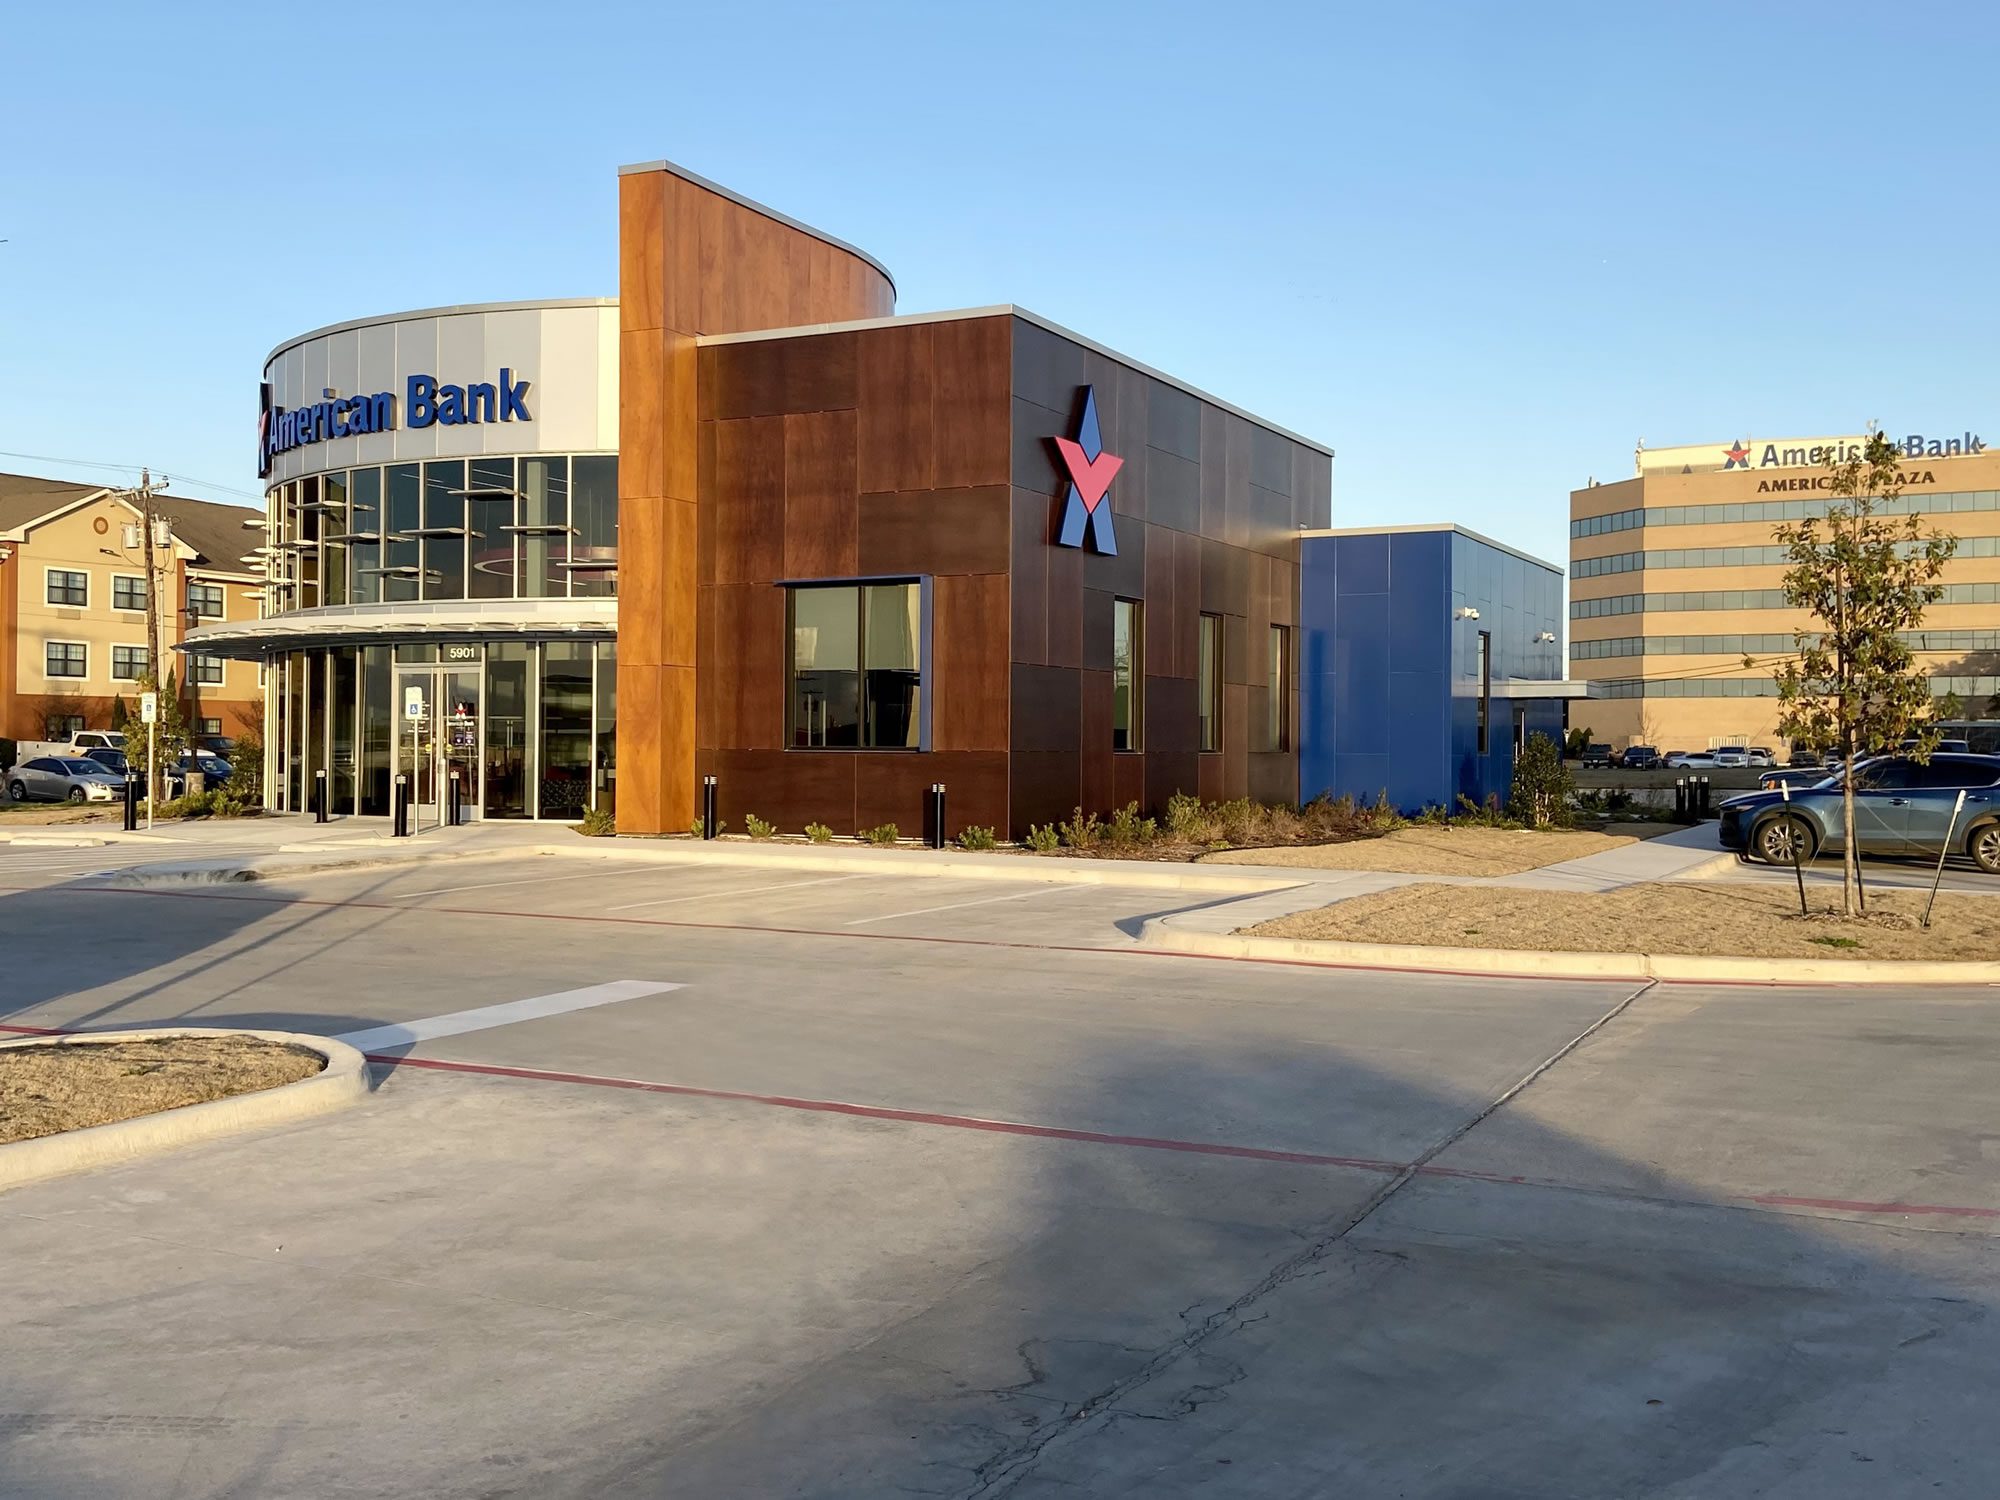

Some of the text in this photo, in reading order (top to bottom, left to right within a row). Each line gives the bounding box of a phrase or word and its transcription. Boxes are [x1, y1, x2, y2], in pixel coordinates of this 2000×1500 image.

[269, 368, 532, 455] American Bank
[1760, 432, 1985, 467] Americ Bank
[1757, 476, 1840, 493] AMERIC
[449, 647, 475, 658] 5901
